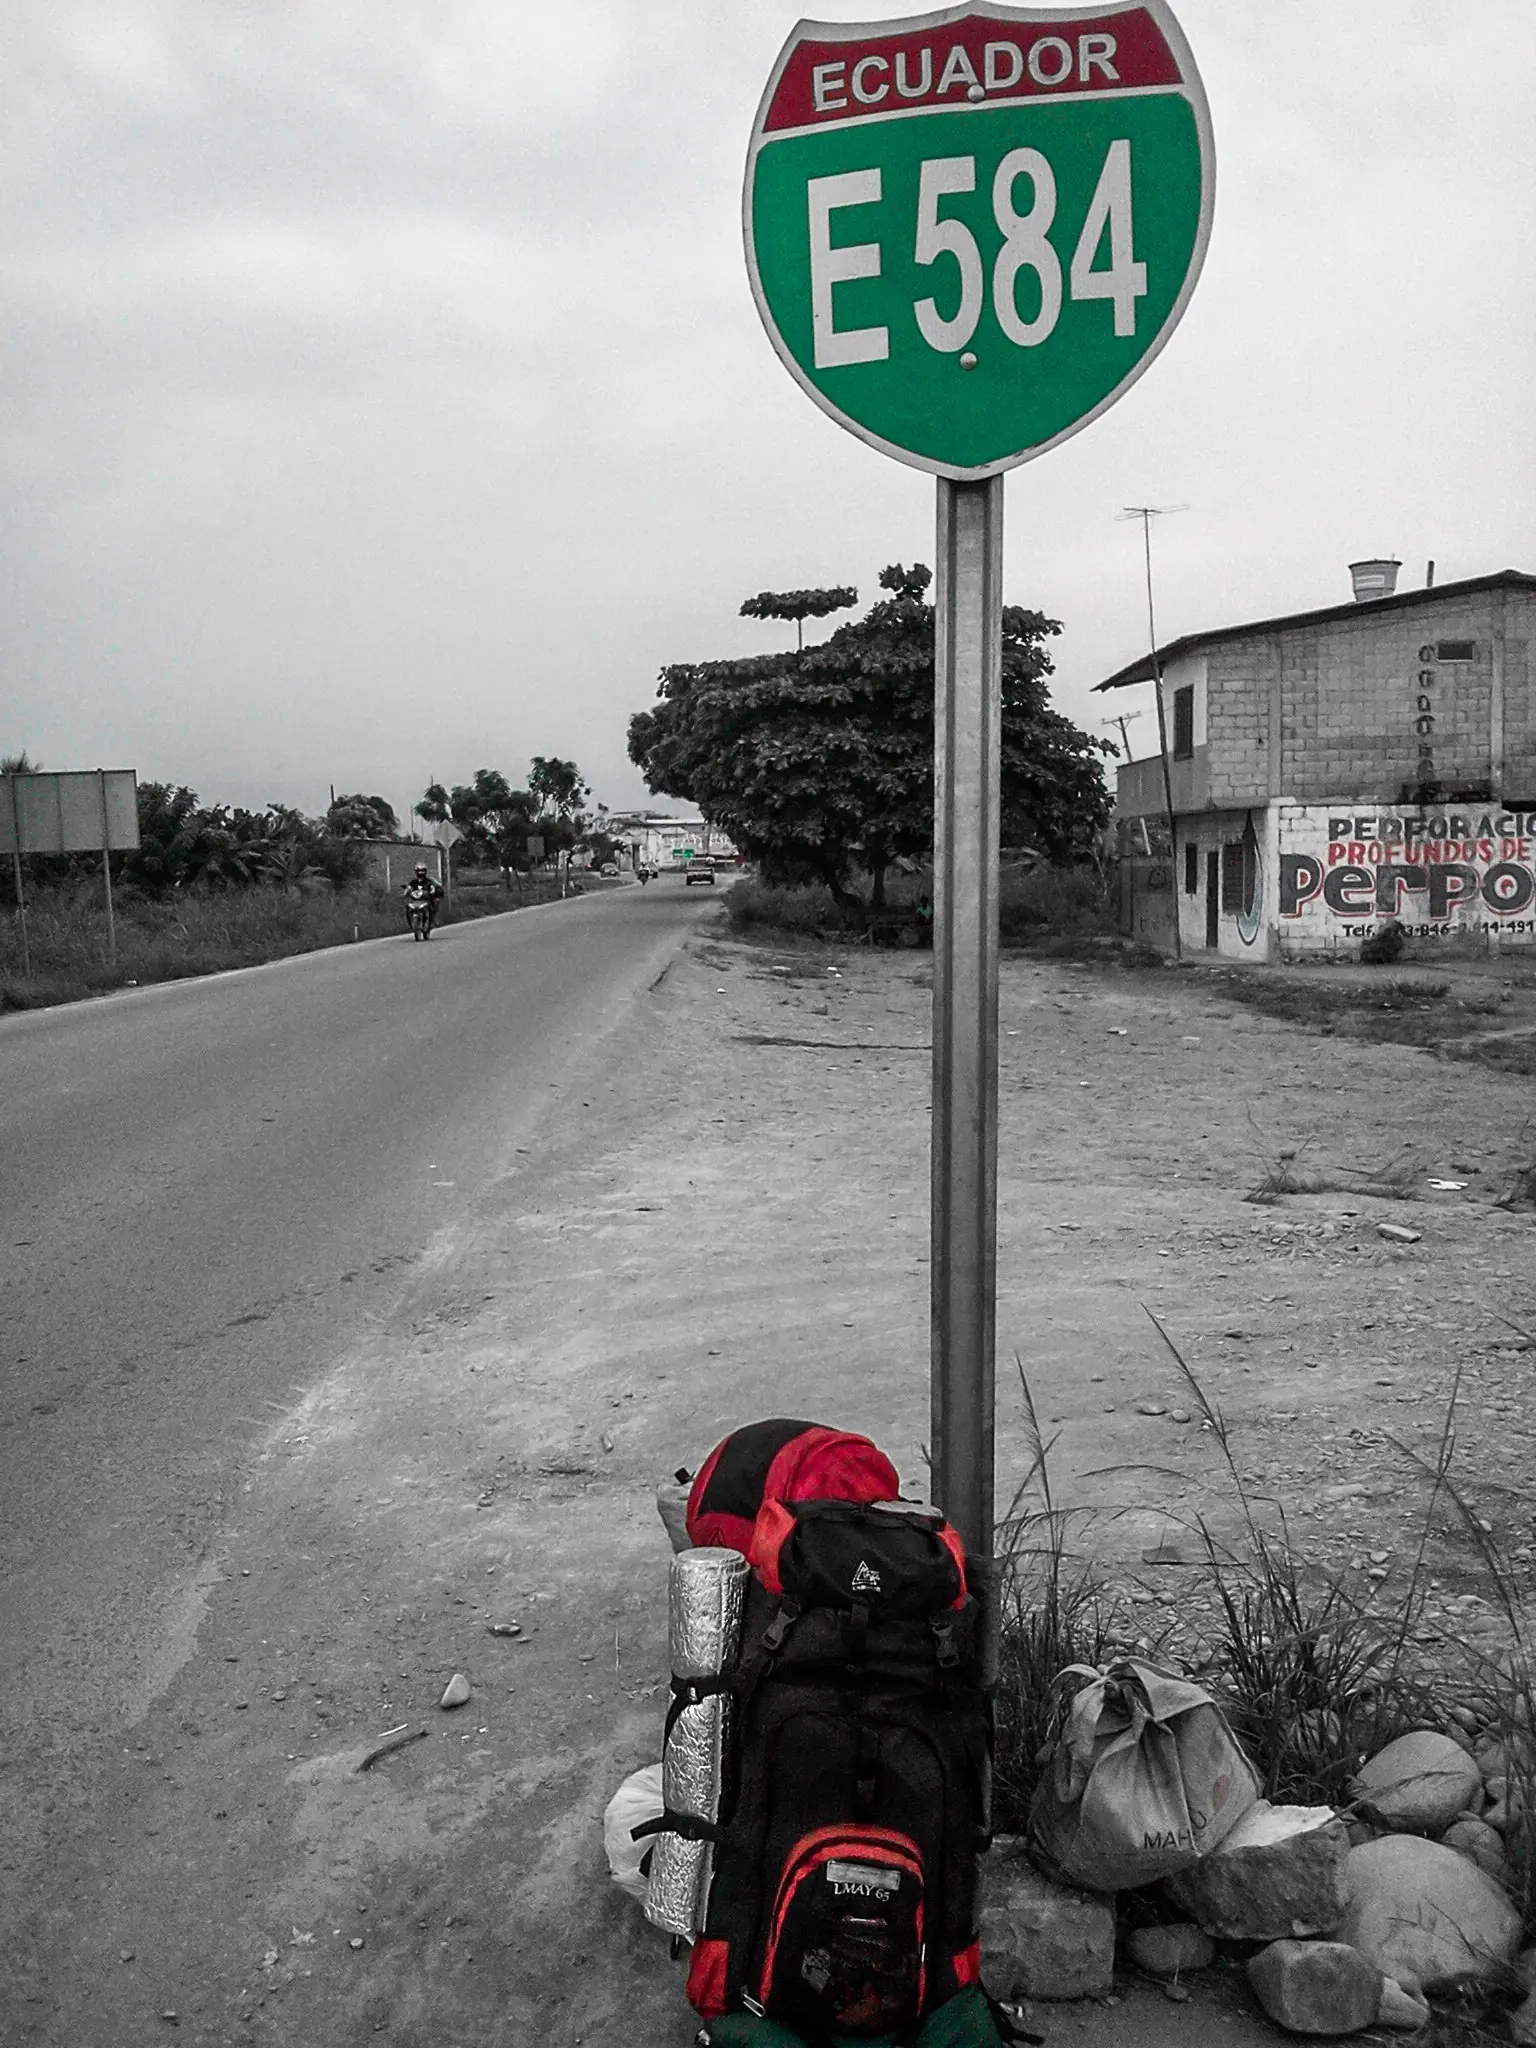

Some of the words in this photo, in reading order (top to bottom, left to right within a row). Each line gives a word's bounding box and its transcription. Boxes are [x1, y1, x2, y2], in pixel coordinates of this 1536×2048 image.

[812, 33, 1121, 112] ECUADOR
[808, 168, 889, 370] E
[913, 138, 1148, 353] 584
[1328, 838, 1494, 866] PROFUNDOS
[1500, 838, 1532, 862] DE
[875, 1888, 891, 1902] 65
